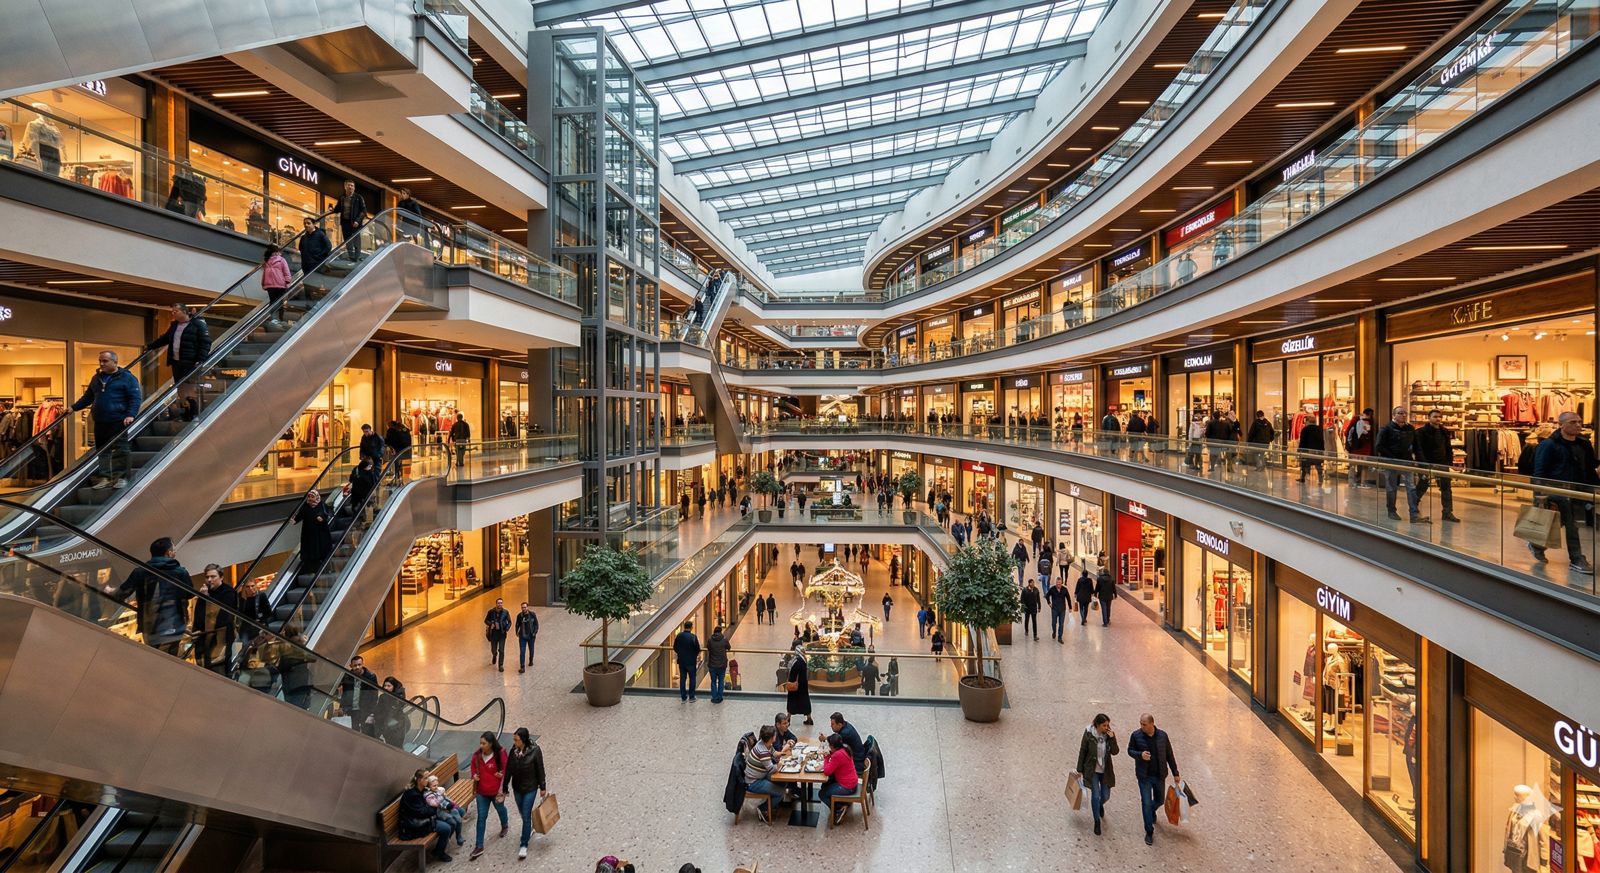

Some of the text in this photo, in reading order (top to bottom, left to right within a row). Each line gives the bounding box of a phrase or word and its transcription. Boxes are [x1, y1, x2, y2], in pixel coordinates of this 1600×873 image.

[279, 157, 319, 185] GİYİM
[1316, 585, 1351, 621] GİYİM
[1553, 720, 1600, 774] GÜ
